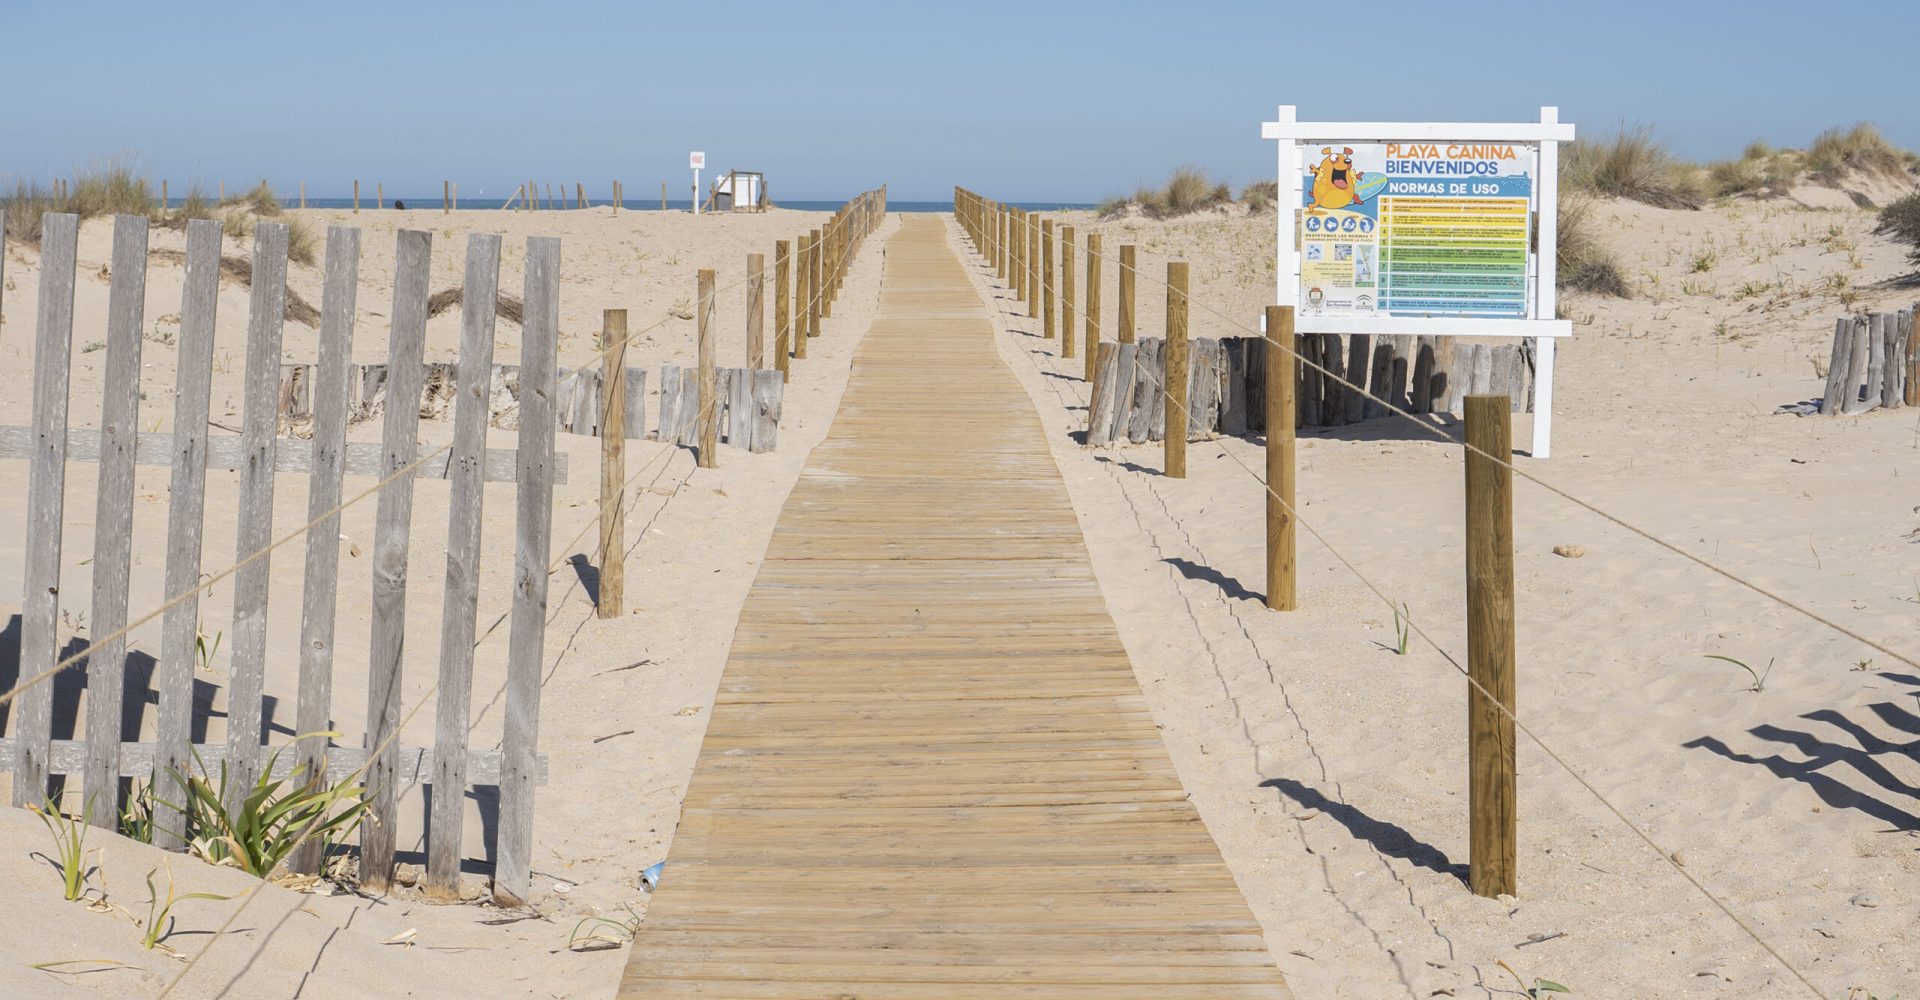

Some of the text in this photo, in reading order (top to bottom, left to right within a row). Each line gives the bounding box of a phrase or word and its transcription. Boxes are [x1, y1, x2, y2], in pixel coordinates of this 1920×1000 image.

[1386, 144, 1516, 160] PLAYA CANINA
[1386, 160, 1498, 175] BIENVENIDOS
[1389, 182, 1500, 194] NORMAS DE USO
